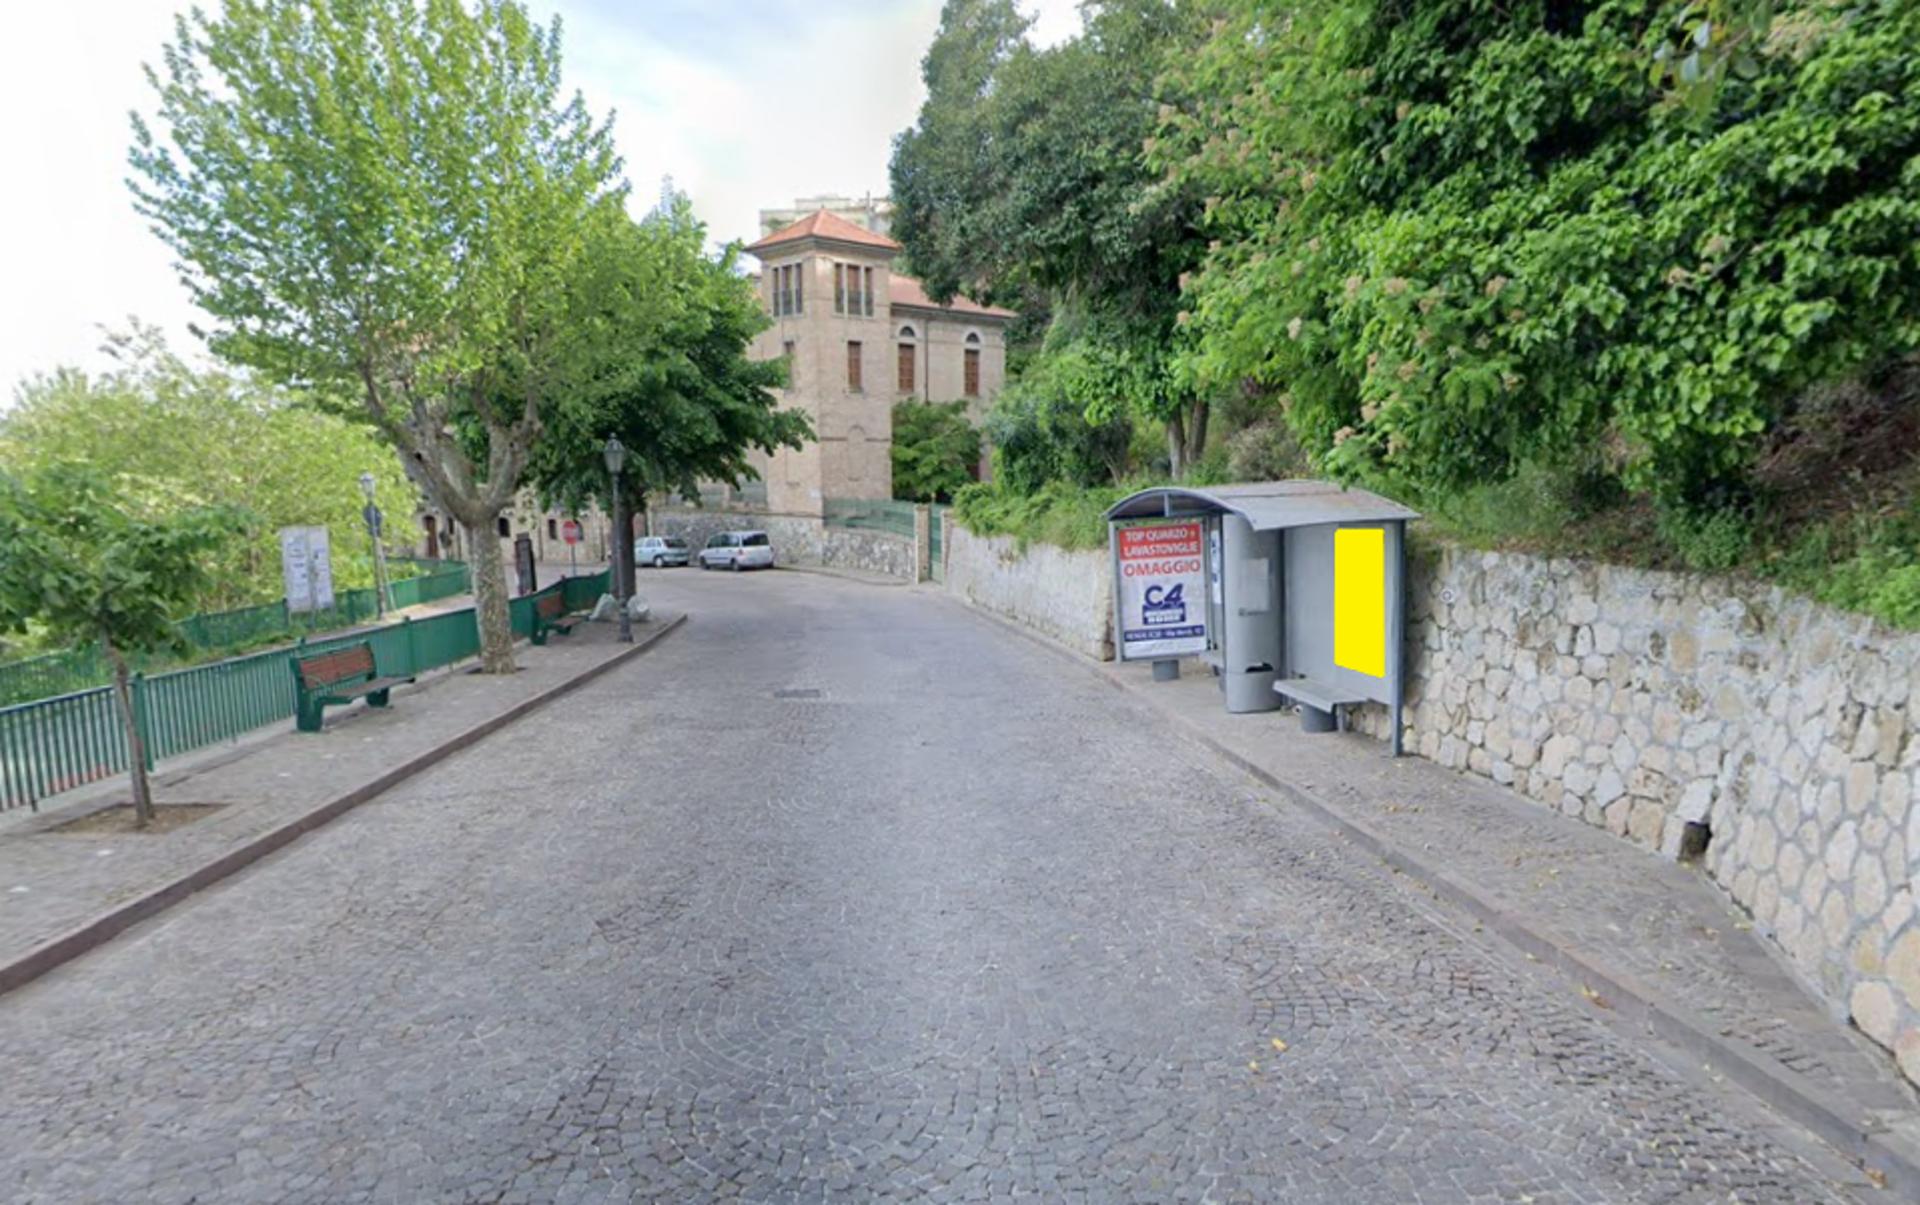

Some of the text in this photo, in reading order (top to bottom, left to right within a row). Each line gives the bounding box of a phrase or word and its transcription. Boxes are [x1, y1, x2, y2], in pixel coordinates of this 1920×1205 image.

[1125, 531, 1145, 542] TOP
[1124, 541, 1199, 557] LAVASTOVIGLIE
[1124, 560, 1200, 577] OMAGGIO
[1145, 583, 1184, 608] C4
